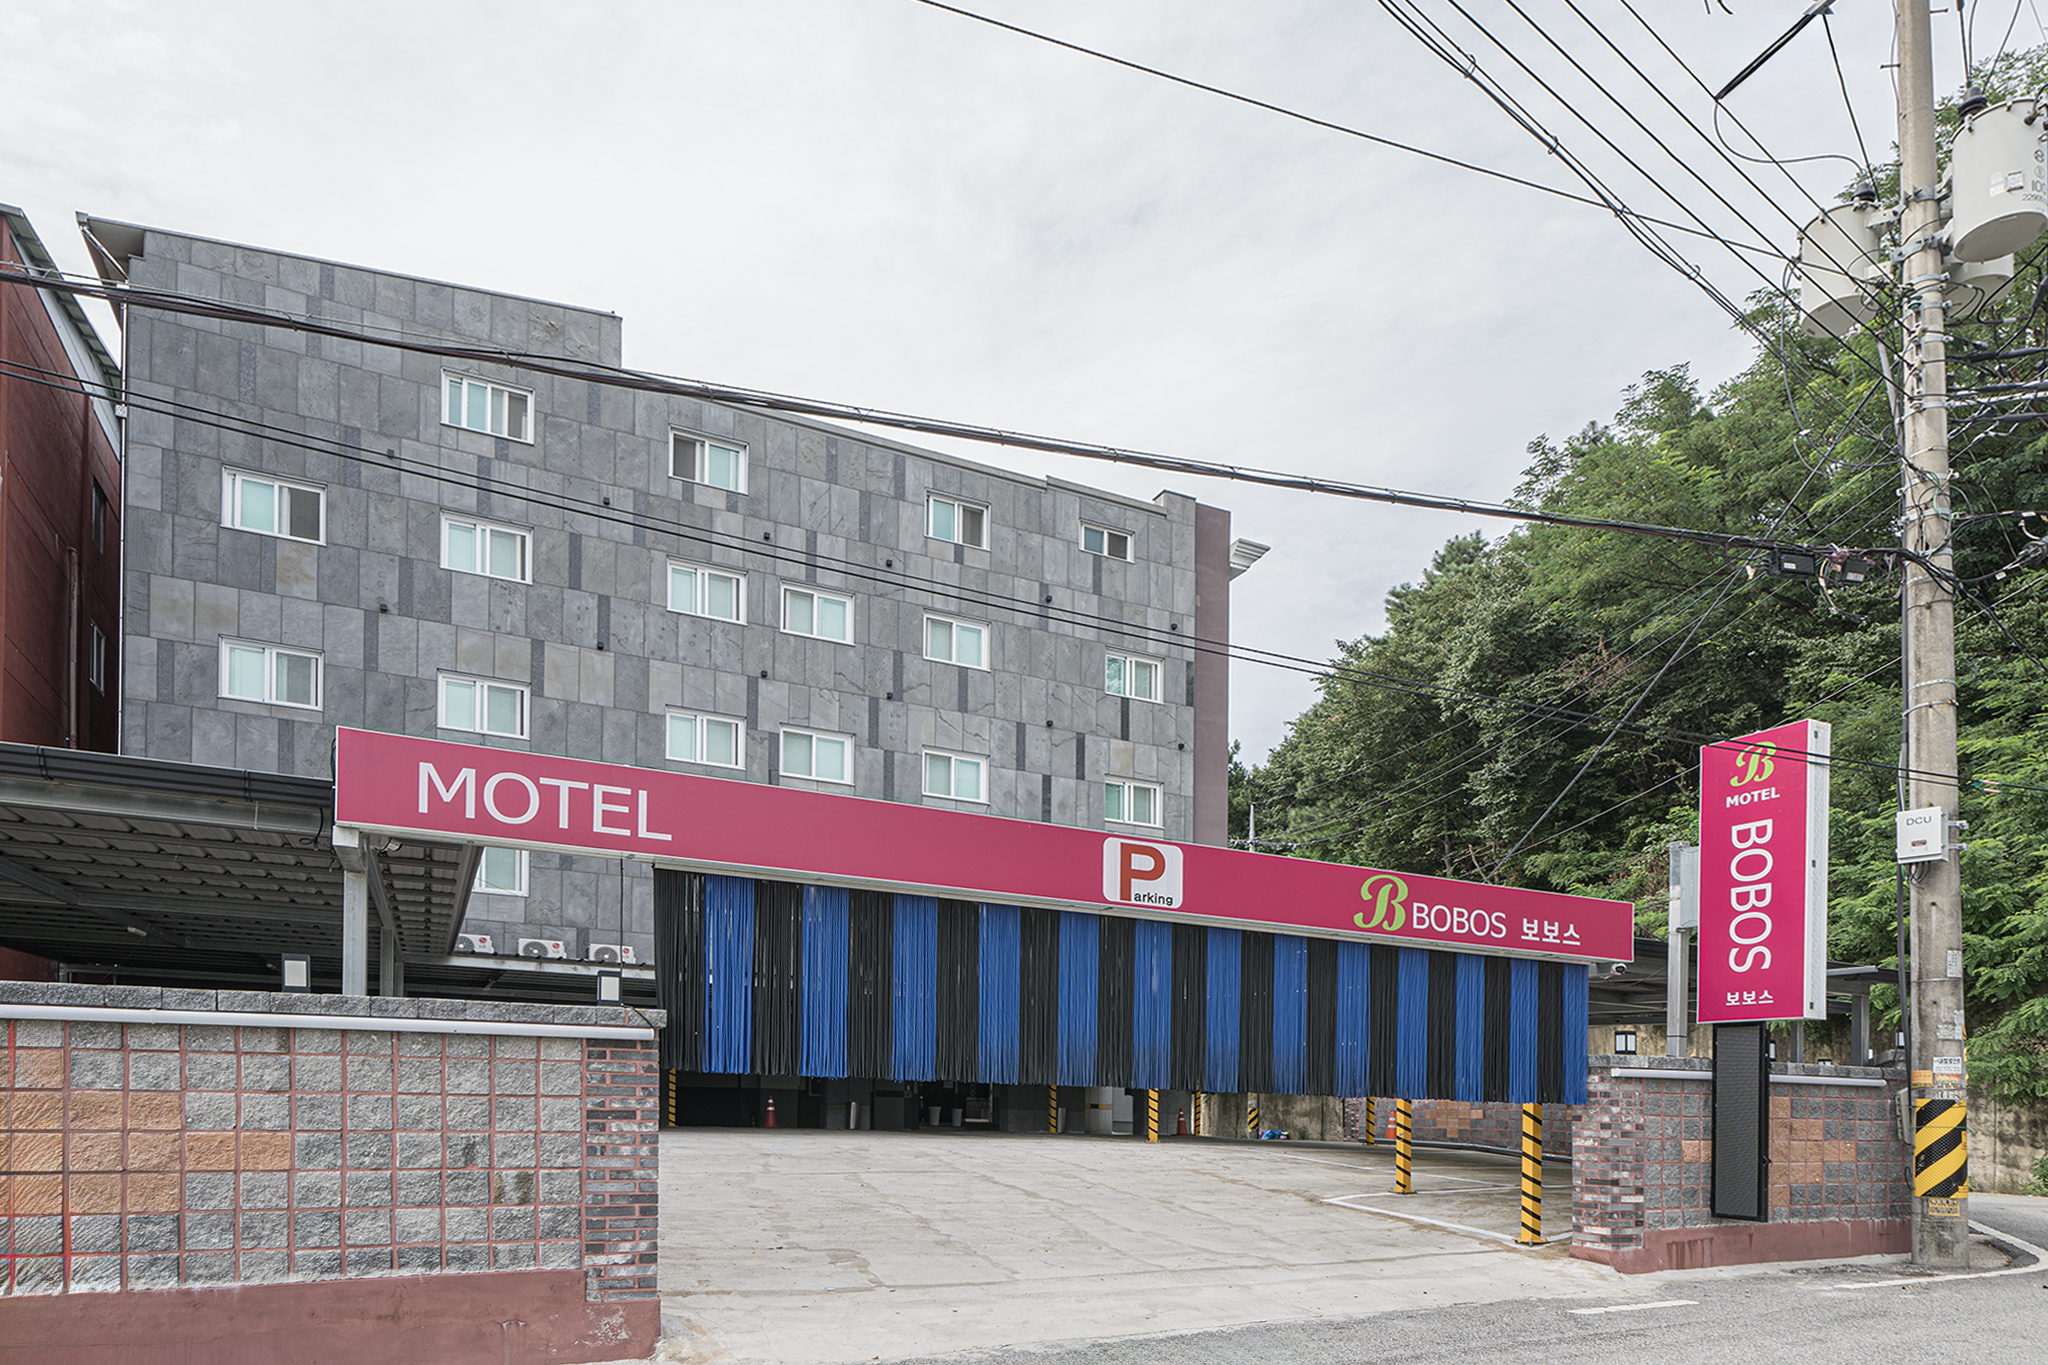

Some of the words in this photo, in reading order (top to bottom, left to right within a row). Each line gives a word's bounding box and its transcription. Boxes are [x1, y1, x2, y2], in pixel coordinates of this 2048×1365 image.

[418, 761, 672, 841] MOTEL
[1726, 787, 1780, 808] MOTEL
[1906, 815, 1932, 826] DCU
[1728, 818, 1773, 973] BOBOS
[1412, 902, 1507, 938] BOBOS
[1520, 918, 1581, 945] 보보스
[1725, 989, 1774, 1006] 보보스
